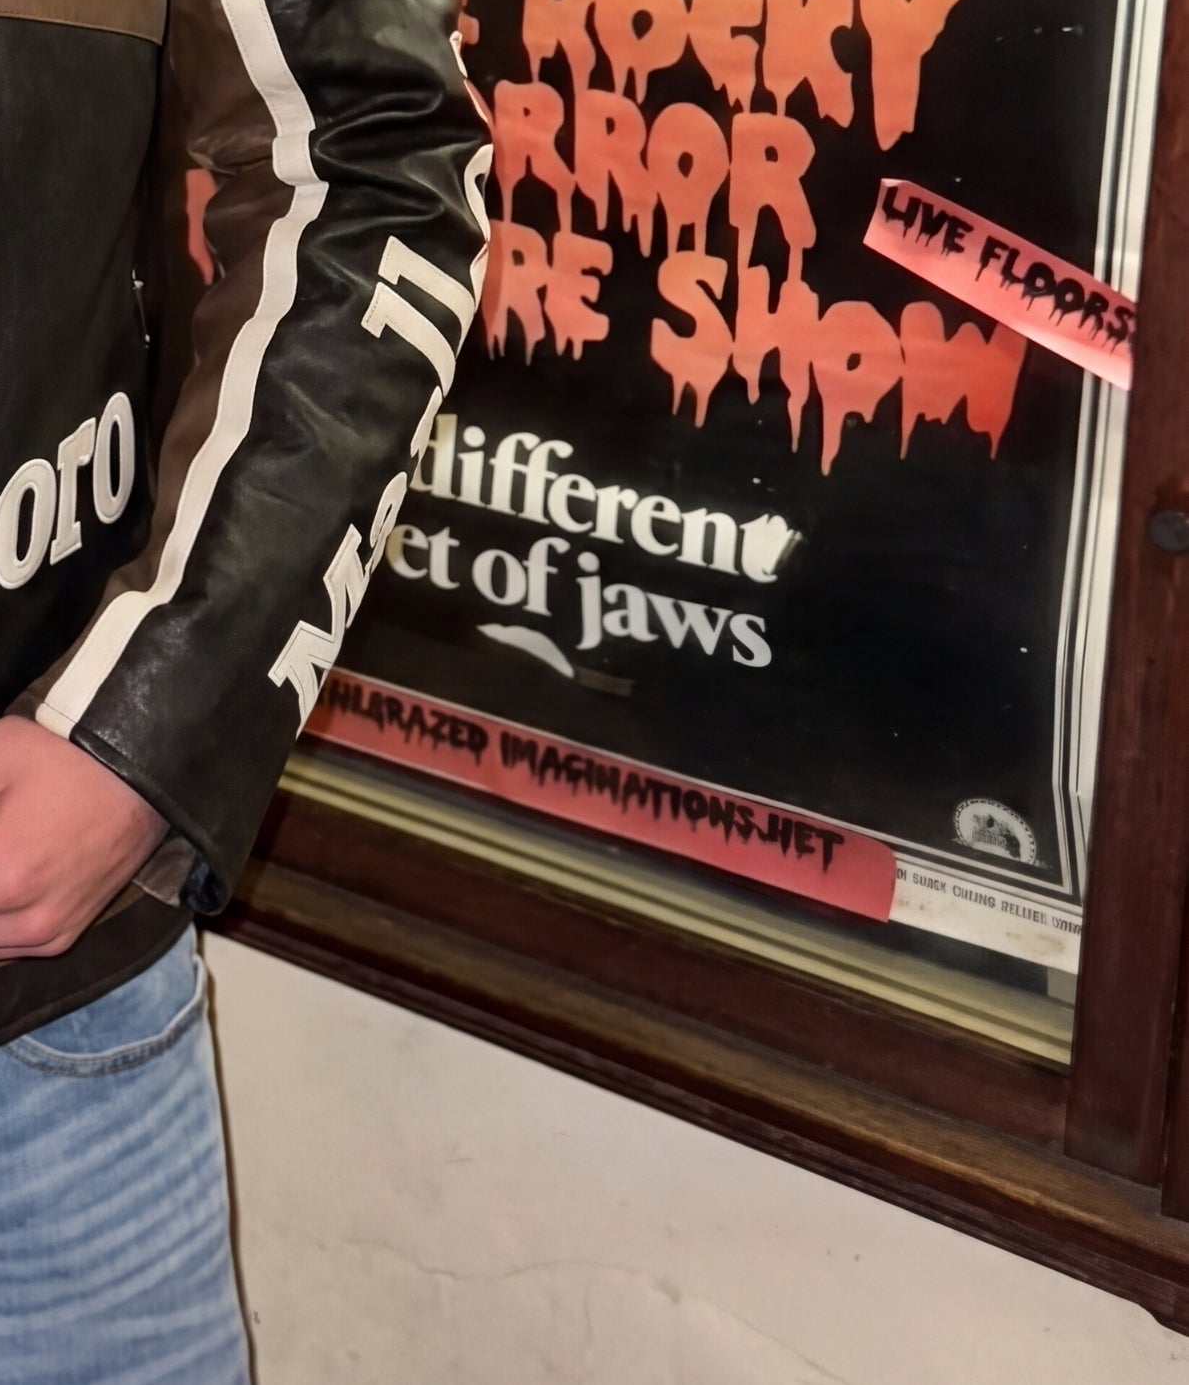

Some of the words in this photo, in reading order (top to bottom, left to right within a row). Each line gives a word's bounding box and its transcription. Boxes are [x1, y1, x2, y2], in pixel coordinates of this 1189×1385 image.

[468, 80, 816, 281] RROR
[881, 185, 974, 257] LIVE
[651, 252, 1027, 477] SHOW
[411, 413, 804, 583] different
[472, 536, 571, 616] of
[576, 550, 773, 667] jaws
